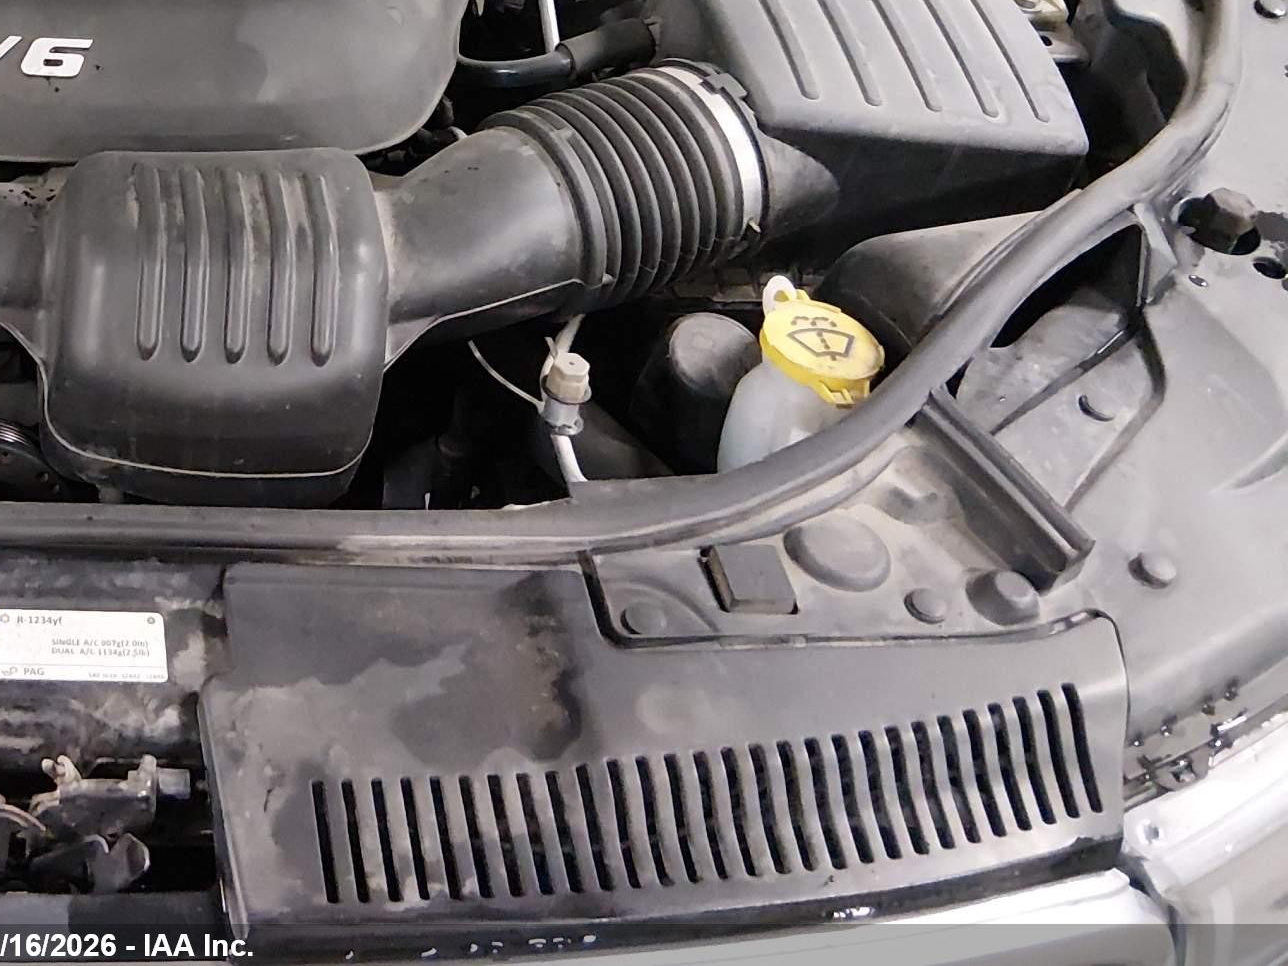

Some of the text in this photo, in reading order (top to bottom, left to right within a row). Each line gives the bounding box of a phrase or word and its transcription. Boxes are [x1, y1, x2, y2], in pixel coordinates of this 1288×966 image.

[16, 615, 63, 626] R-1234yf
[51, 638, 80, 647] SINGLE
[83, 639, 99, 647] A/C
[51, 647, 75, 655] DUAL
[79, 648, 96, 656] A/C
[23, 667, 46, 677] PAG
